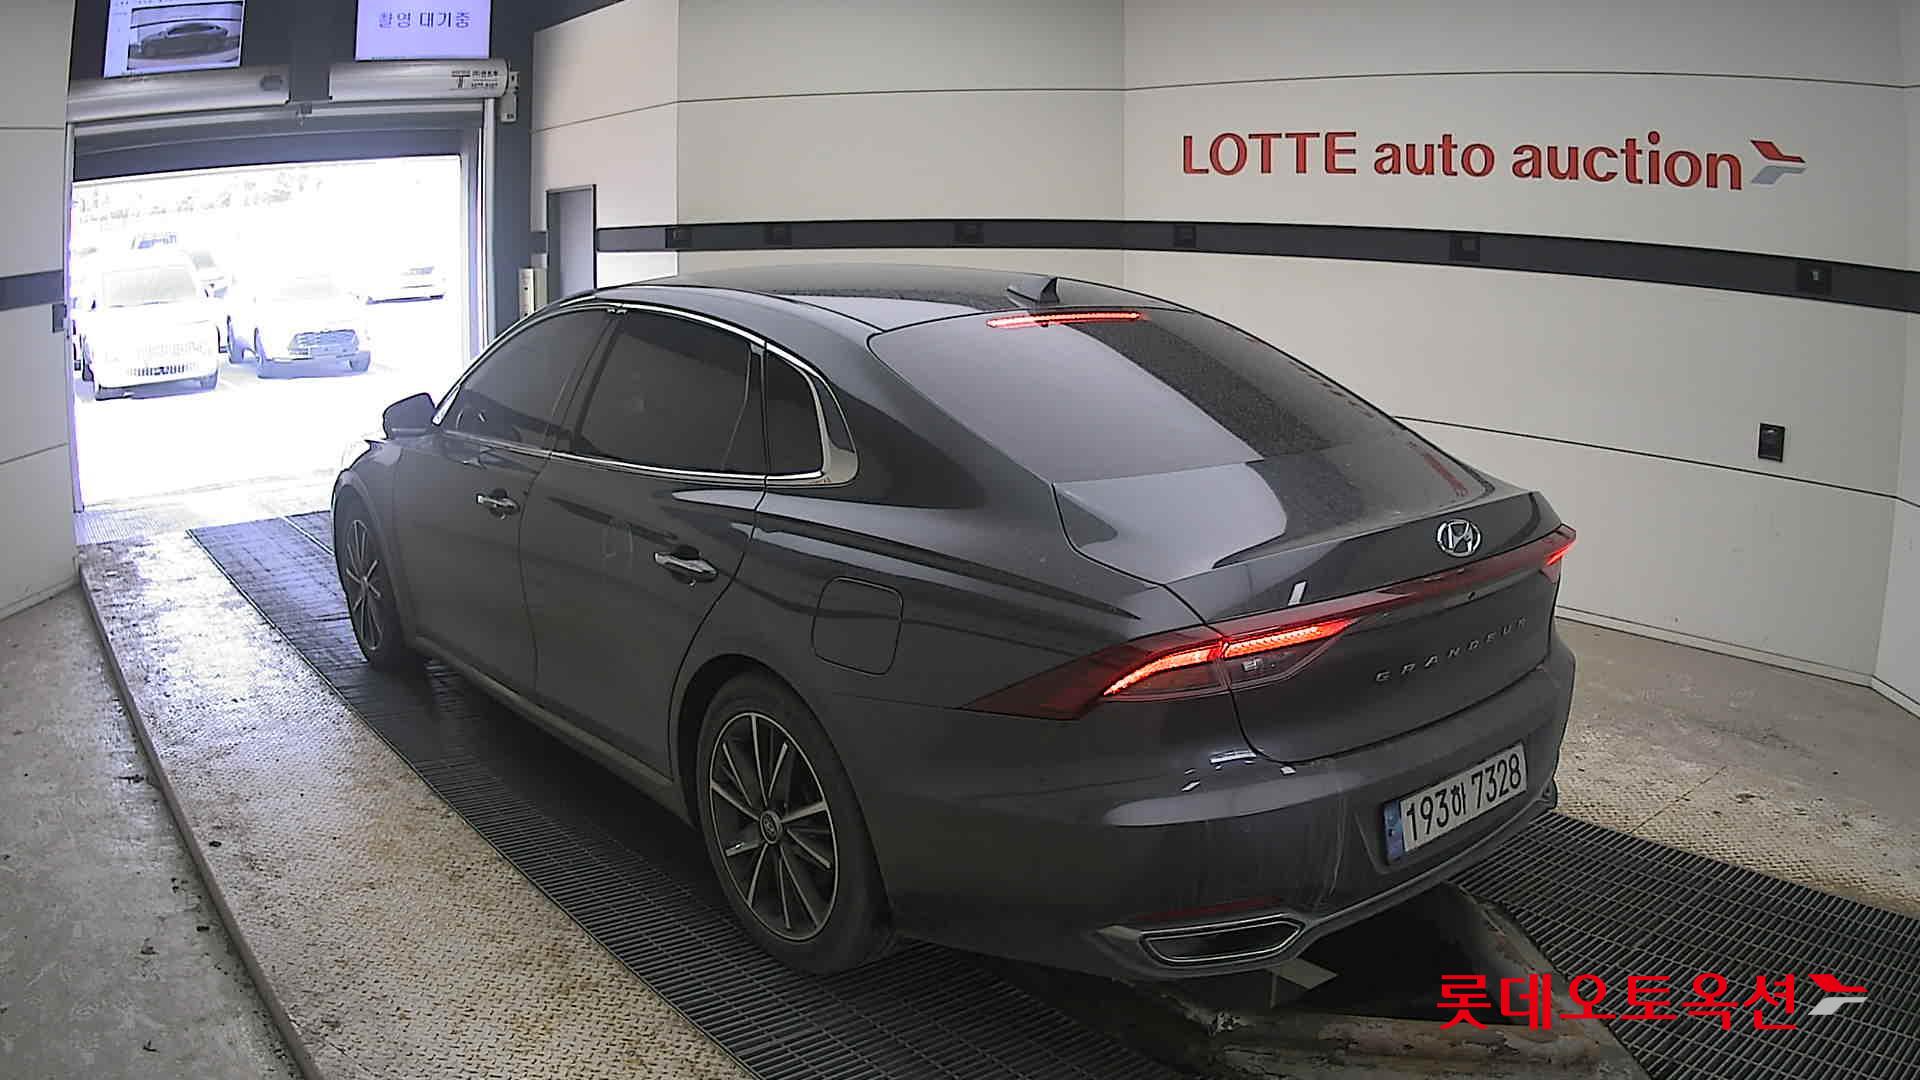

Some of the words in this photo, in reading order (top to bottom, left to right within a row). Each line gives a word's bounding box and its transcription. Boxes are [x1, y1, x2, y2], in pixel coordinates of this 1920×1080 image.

[419, 11, 472, 29] 대기중
[1182, 131, 1357, 176] LOTTE
[1374, 133, 1496, 177] auto
[1511, 130, 1743, 191] auction
[1375, 615, 1528, 682] GRANDEUR
[1406, 781, 1467, 841] 193하
[1471, 753, 1522, 809] 7328
